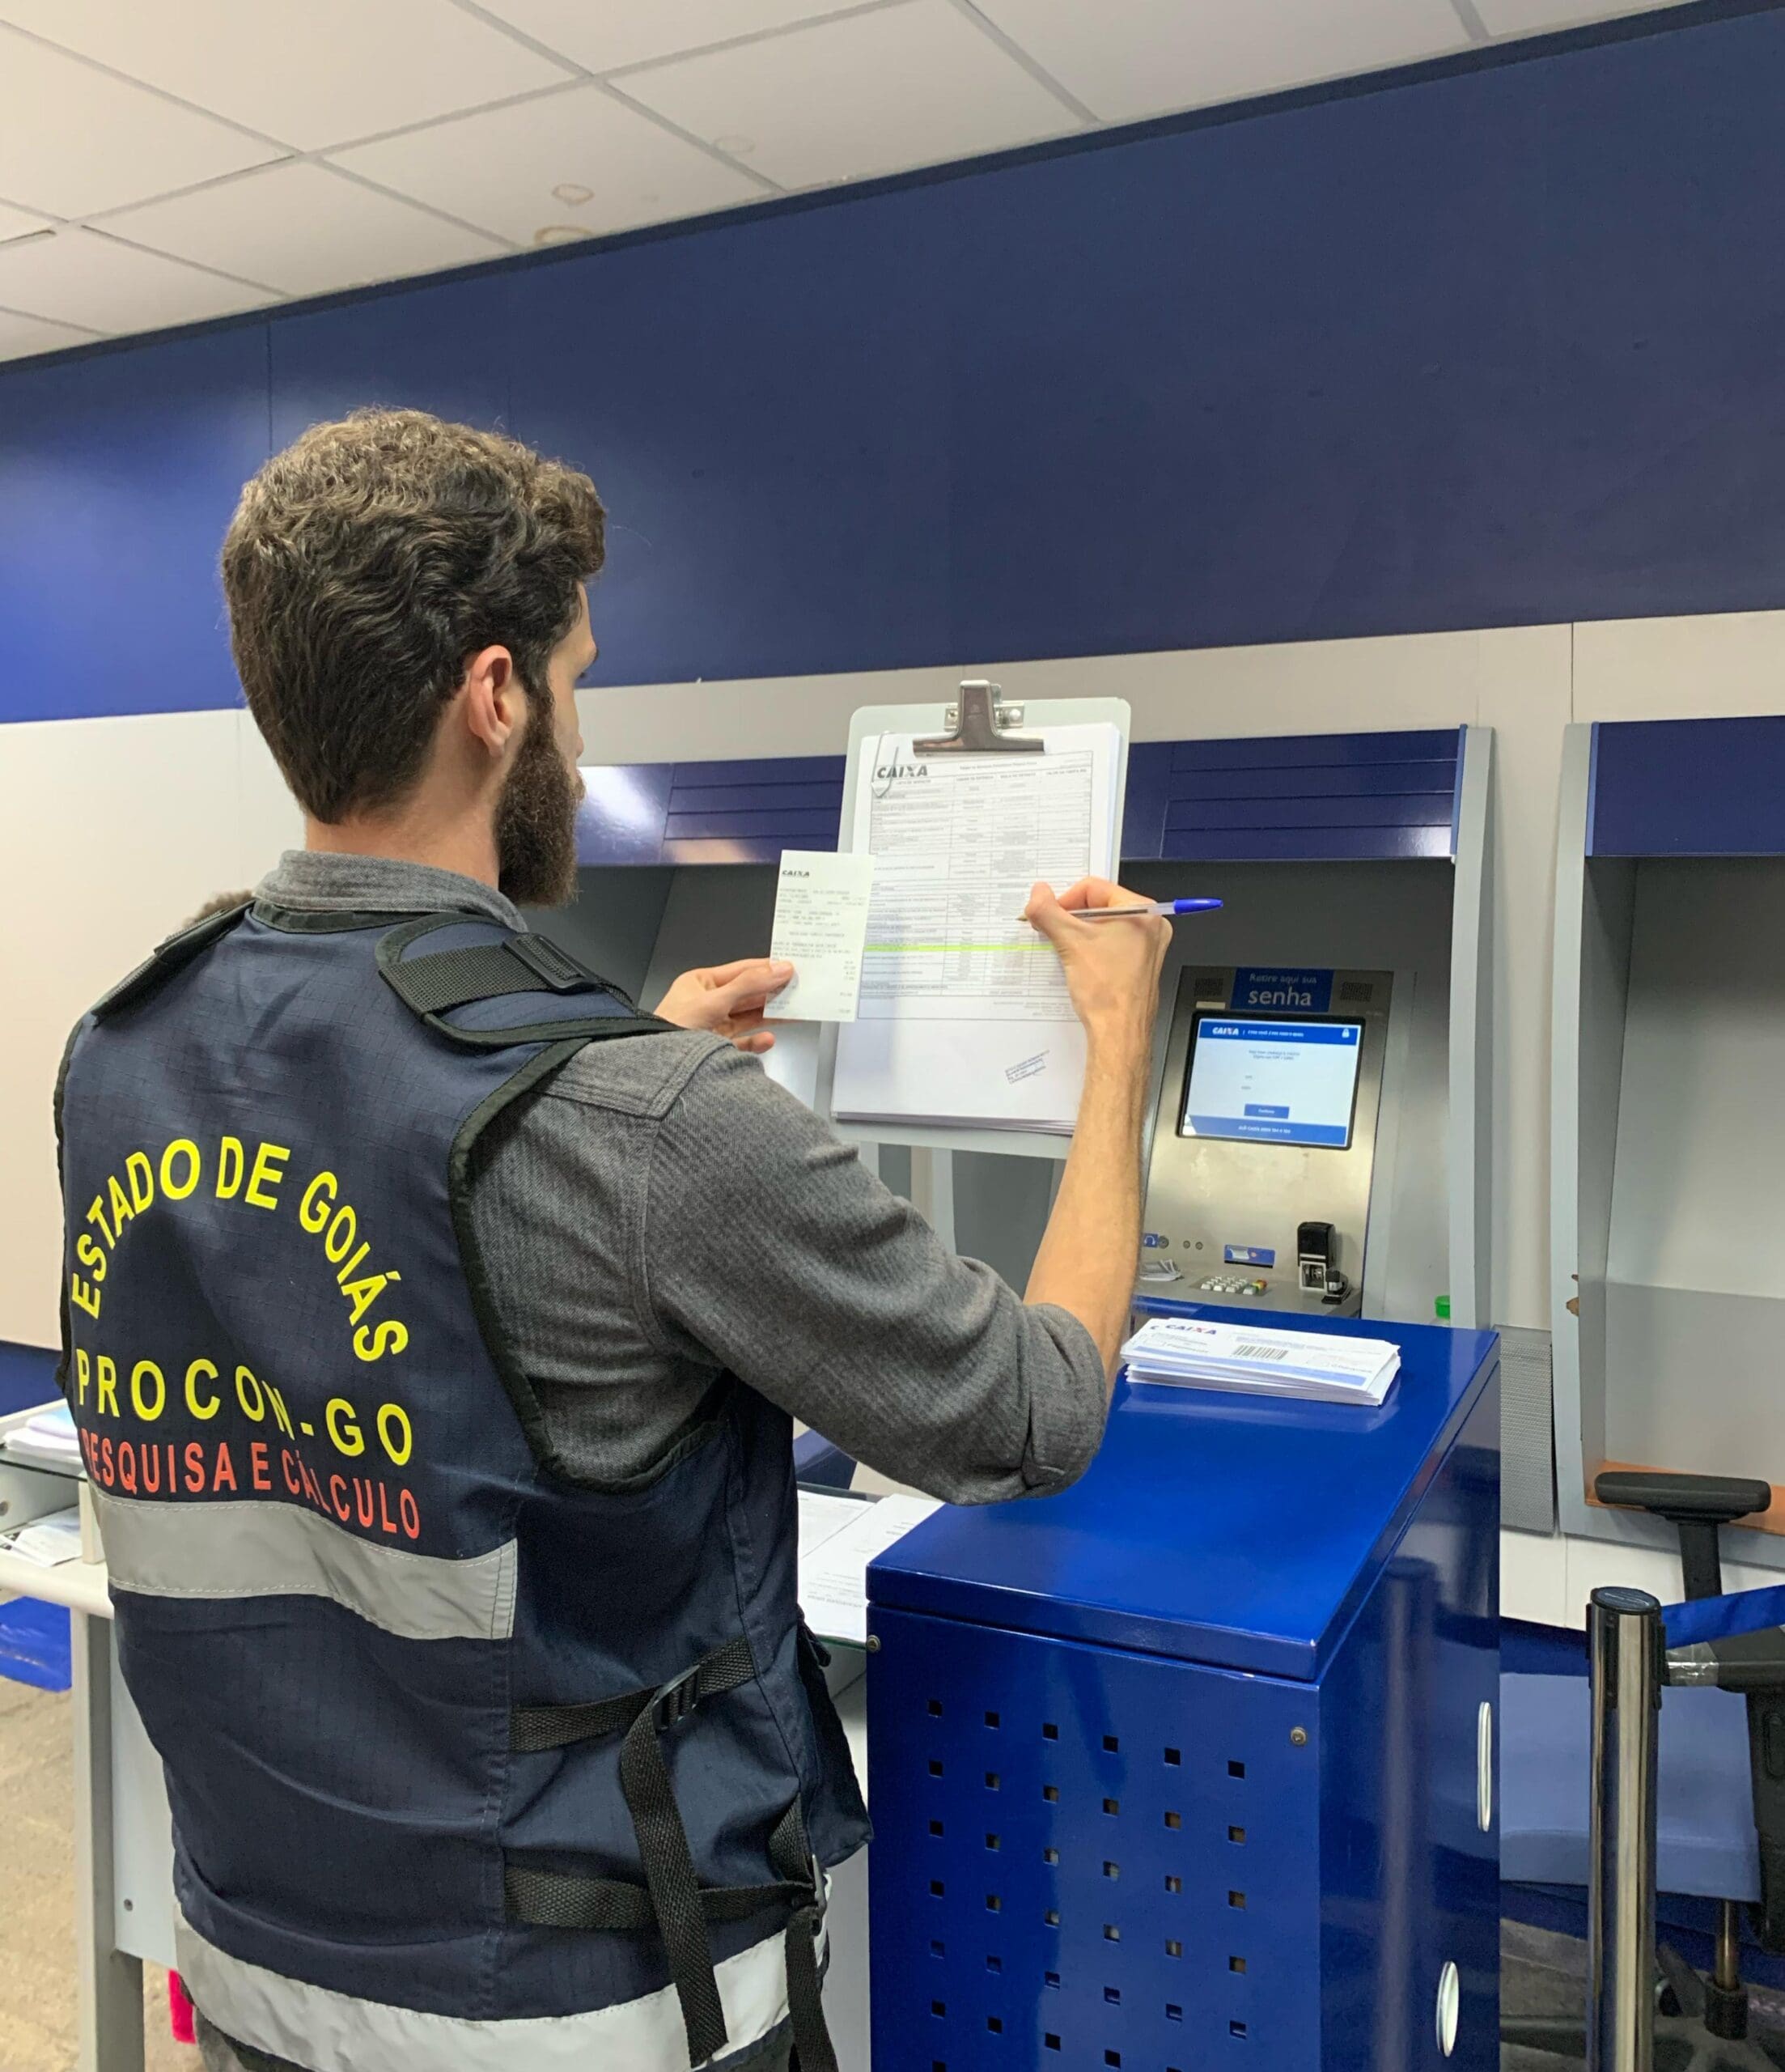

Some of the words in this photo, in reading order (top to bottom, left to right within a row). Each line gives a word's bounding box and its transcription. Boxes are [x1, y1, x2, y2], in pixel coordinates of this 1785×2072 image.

[876, 765, 928, 778] CAIXA
[782, 869, 810, 877] CAIXA
[1249, 973, 1278, 983] Retire
[1280, 975, 1300, 984] aqui
[1248, 987, 1312, 1006] senha
[1212, 1025, 1240, 1036] CAIXA
[71, 1138, 201, 1319] ESTADO
[215, 1136, 291, 1210] DE
[299, 1170, 409, 1362] GOIÁS
[1165, 1325, 1217, 1335] CAIXA
[81, 1428, 238, 1495] PESQUISA
[251, 1442, 272, 1490] E
[281, 1449, 421, 1539] CÁLCULO
